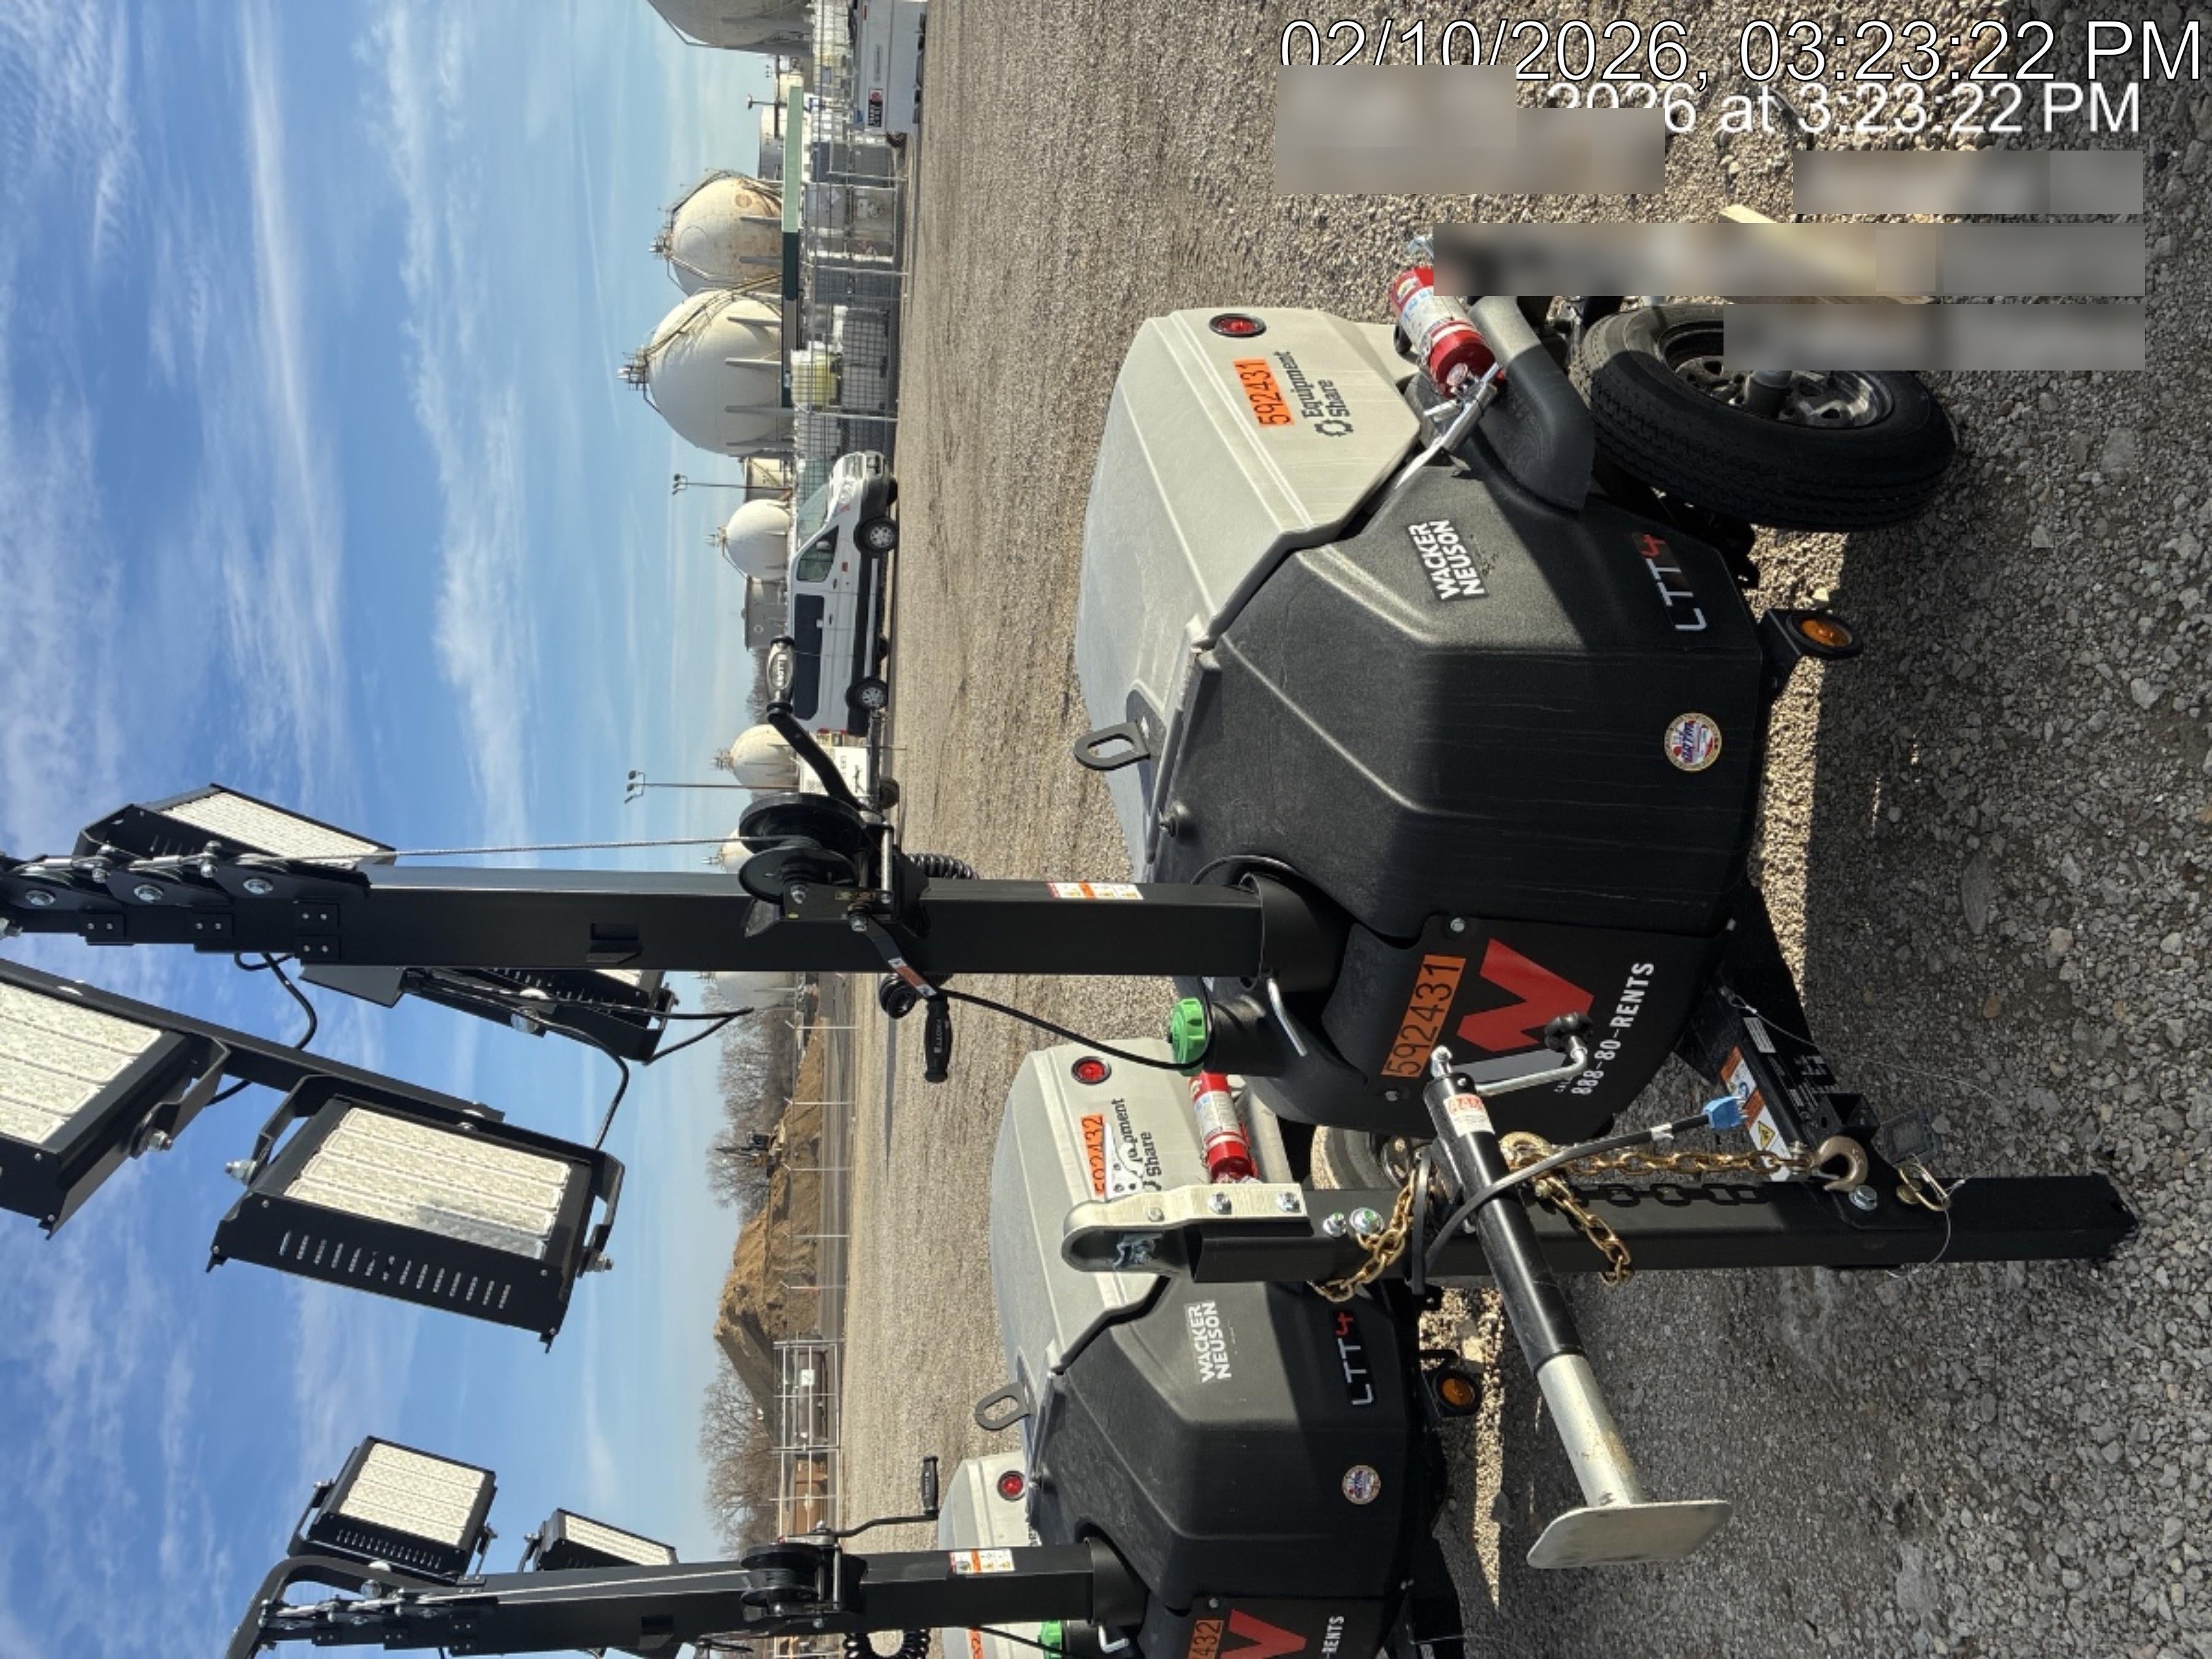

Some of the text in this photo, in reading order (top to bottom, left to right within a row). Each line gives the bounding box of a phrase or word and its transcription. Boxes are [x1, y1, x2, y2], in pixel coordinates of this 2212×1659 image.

[1234, 362, 1291, 424] 592431
[1273, 351, 1324, 418] Equipment
[1317, 380, 1350, 417] Share
[1408, 522, 1461, 600] WACKER
[1428, 519, 1485, 595] NEUSON
[1641, 534, 1708, 630] LTT4
[1386, 963, 1461, 1075] 592431
[1570, 962, 1655, 1096] 888-80-RENTS
[1140, 1131, 1162, 1176] Share
[1188, 1304, 1215, 1382] WACKER
[1201, 1301, 1232, 1379] NEUSON
[1335, 1312, 1374, 1405] LTT4
[1191, 1622, 1220, 1657] 432
